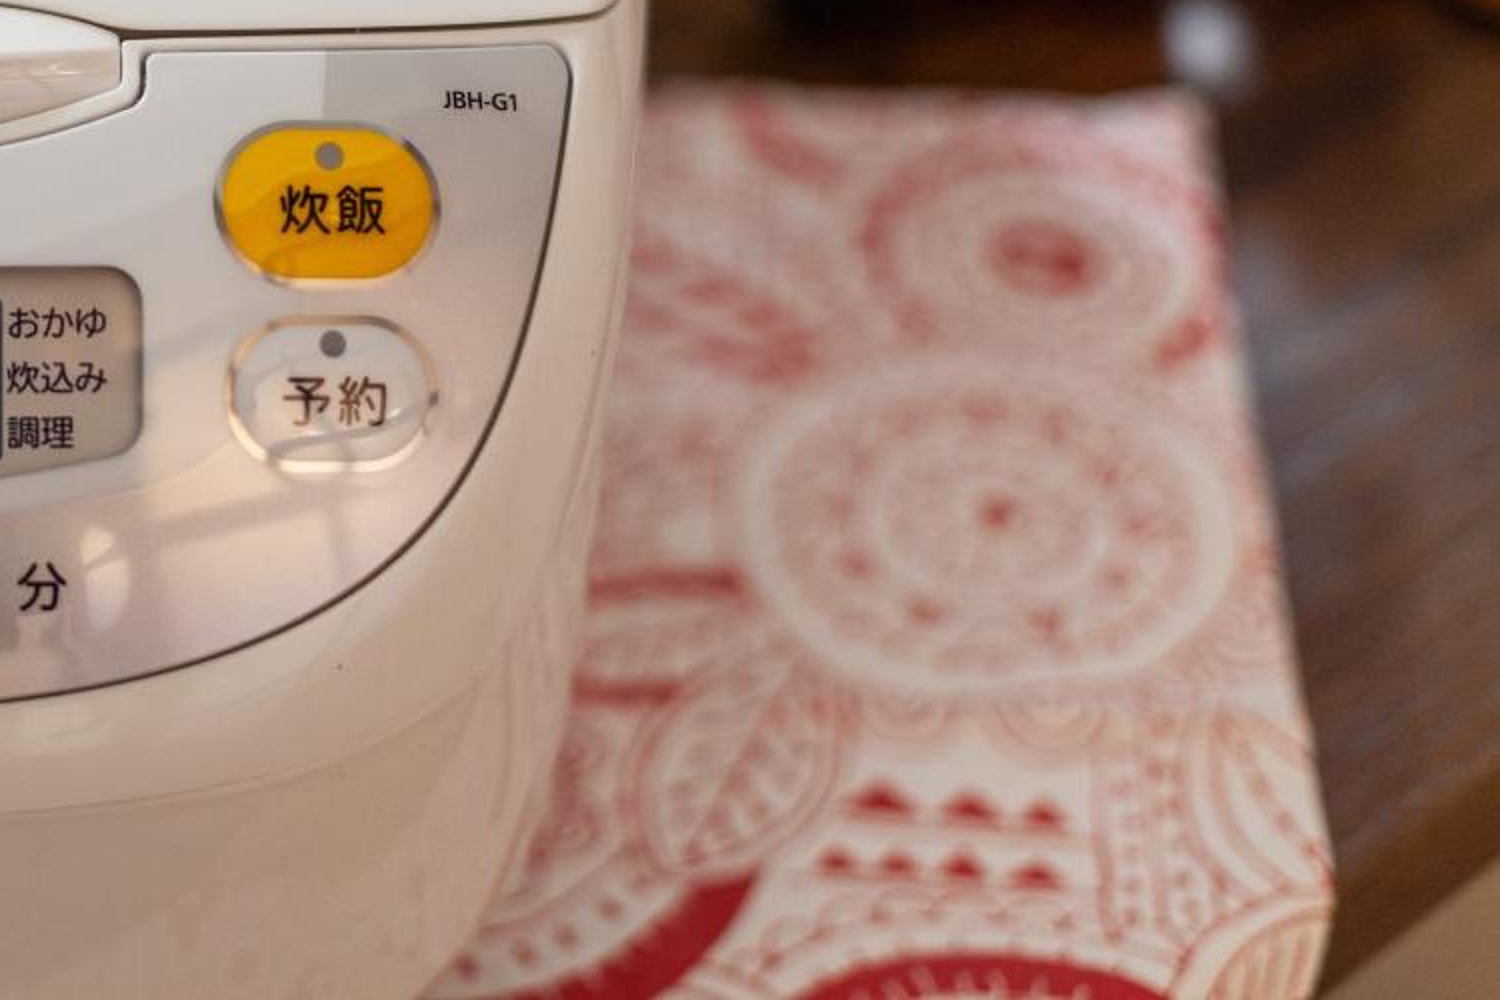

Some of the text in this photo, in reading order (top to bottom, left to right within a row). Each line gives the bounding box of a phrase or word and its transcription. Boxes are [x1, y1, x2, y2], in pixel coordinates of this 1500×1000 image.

[443, 90, 518, 112] JBH-G1
[279, 185, 386, 235] 炊飯
[7, 307, 107, 339] おかゆ
[6, 361, 108, 395] 炊込み
[281, 375, 388, 429] 予約
[7, 416, 75, 450] 調理
[16, 562, 67, 613] 分
